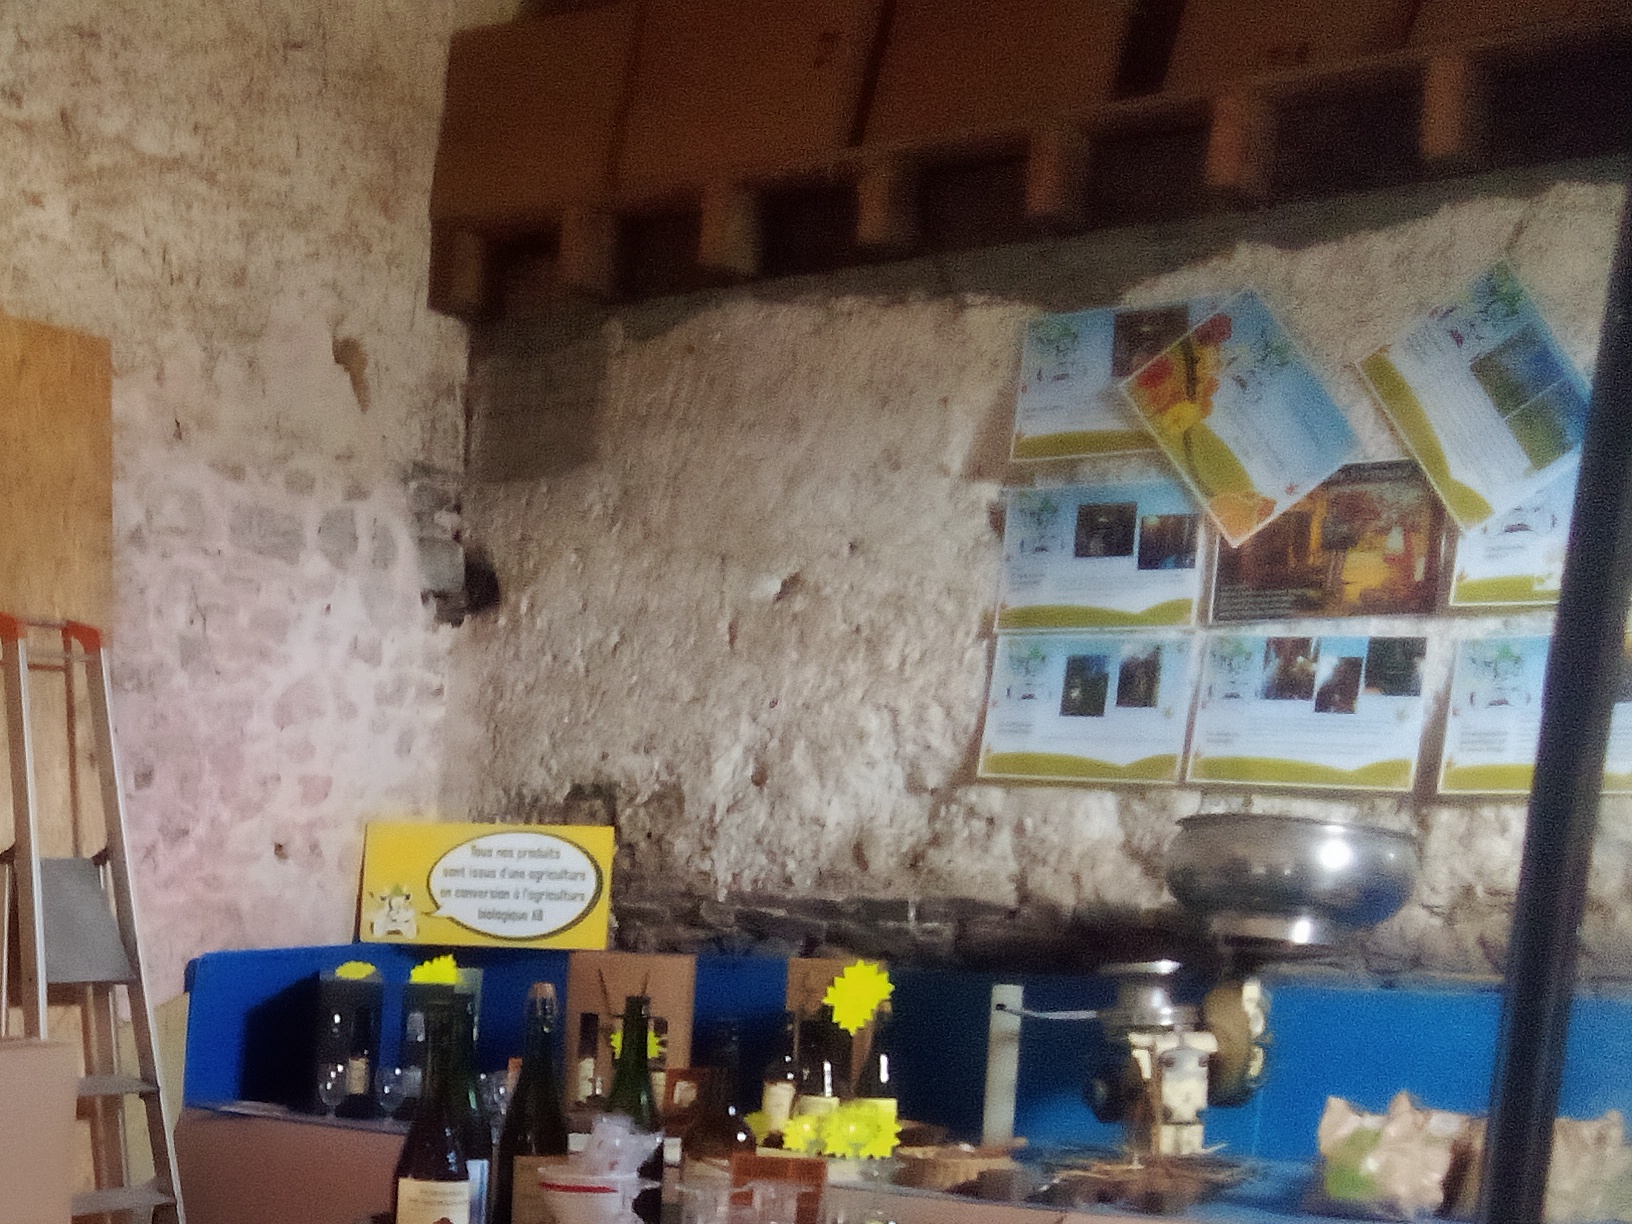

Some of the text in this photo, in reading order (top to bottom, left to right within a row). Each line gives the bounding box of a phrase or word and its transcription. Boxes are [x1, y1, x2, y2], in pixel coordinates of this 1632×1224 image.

[496, 849, 514, 858] nos
[517, 847, 561, 861] produits
[442, 867, 586, 883] sont issus d'une agriculture
[454, 887, 510, 899] conversion
[522, 887, 586, 903] l'agriculture
[477, 908, 528, 923] biologique
